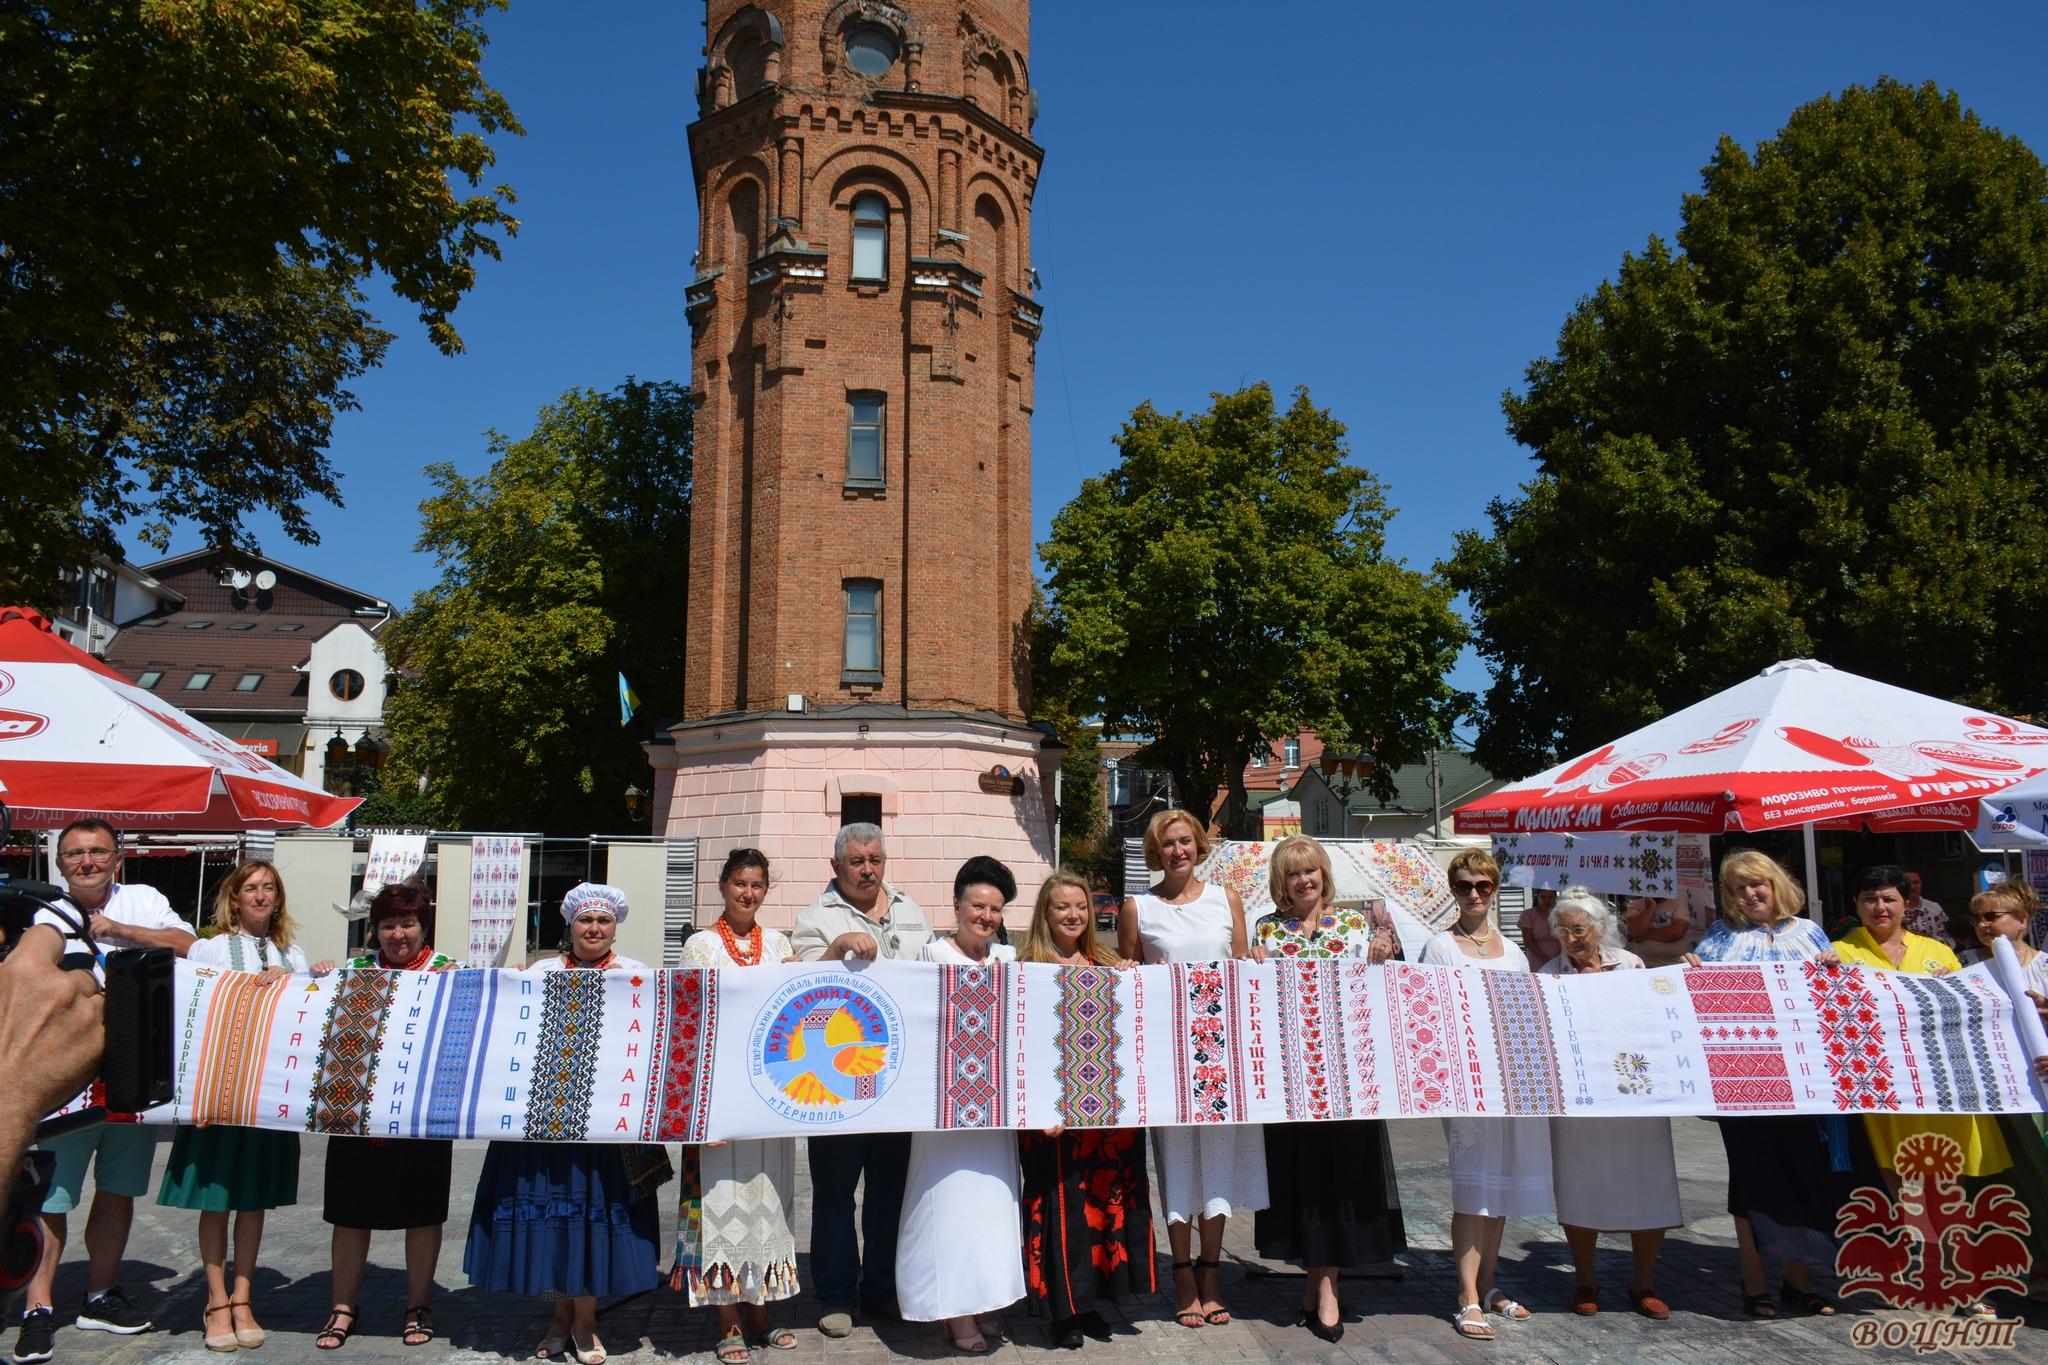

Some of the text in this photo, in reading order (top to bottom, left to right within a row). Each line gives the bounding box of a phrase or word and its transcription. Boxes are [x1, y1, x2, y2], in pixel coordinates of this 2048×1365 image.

[1763, 810, 1782, 821] БЕЗ
[615, 993, 642, 1132] КАНАДА
[768, 1013, 789, 1053] ЦВІТ
[1665, 1007, 1696, 1095] КРИМ
